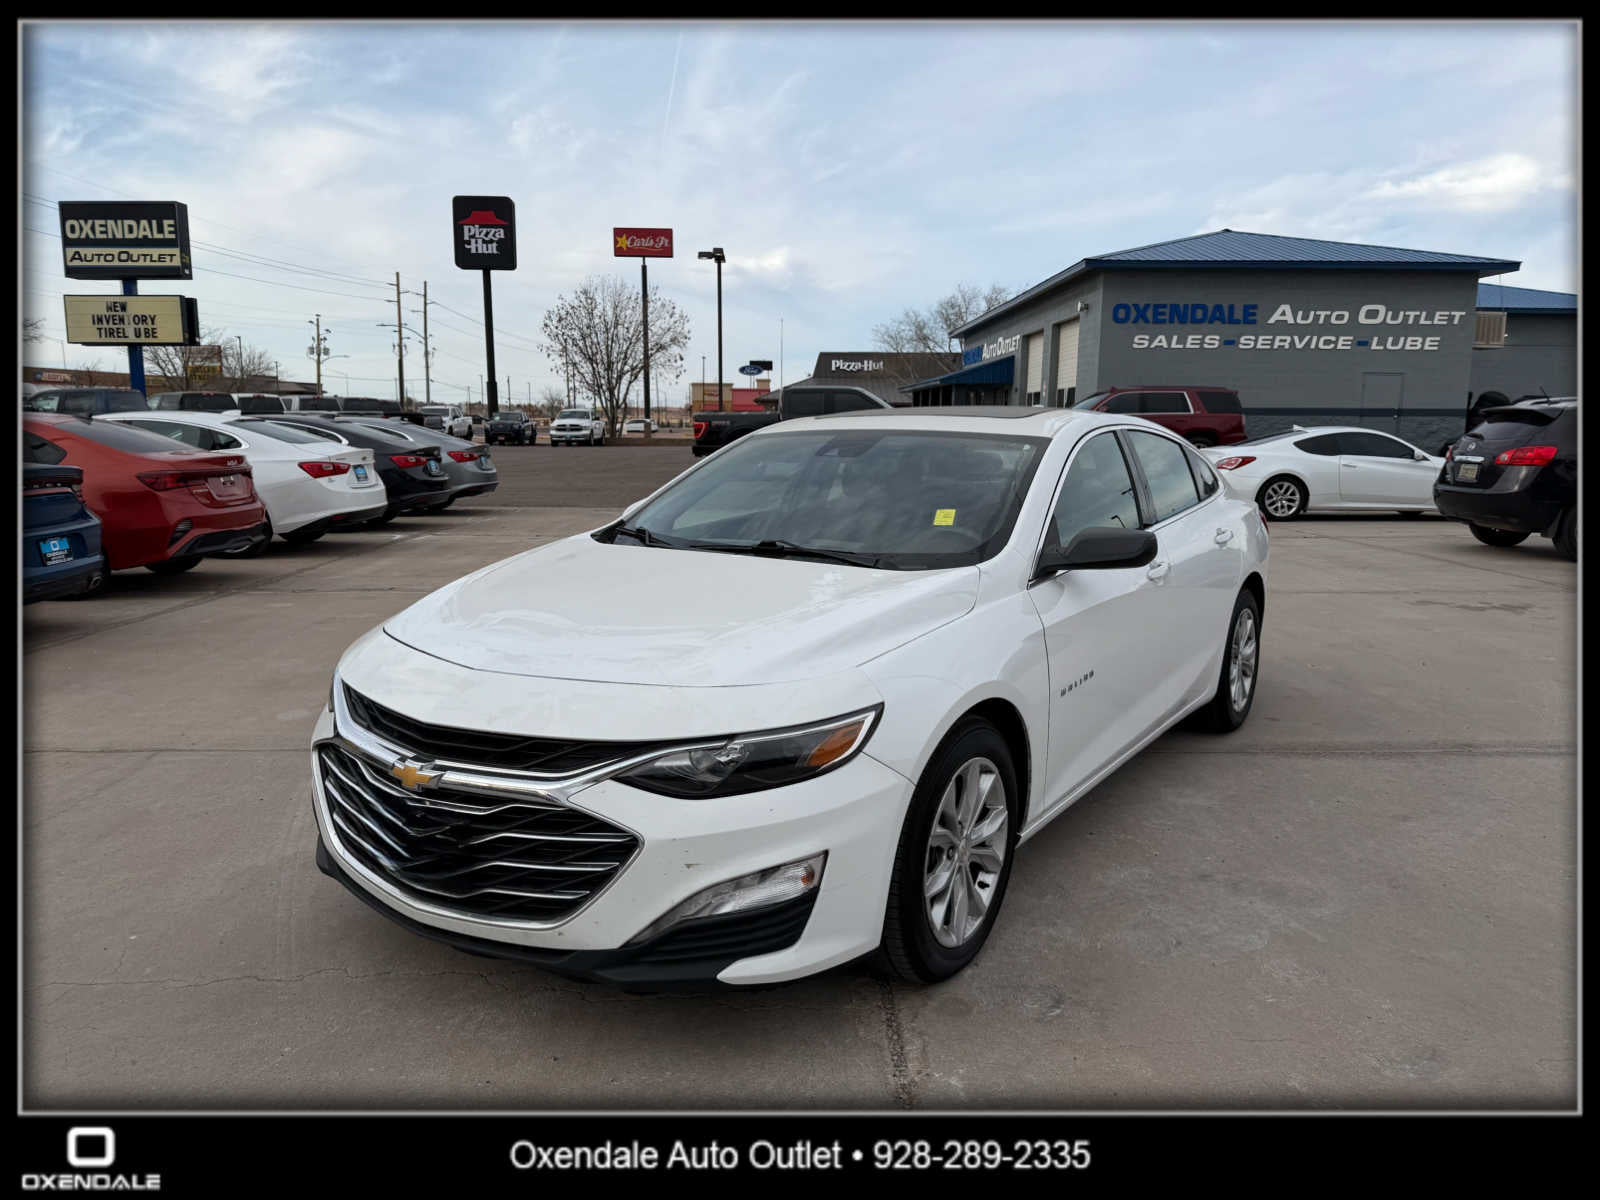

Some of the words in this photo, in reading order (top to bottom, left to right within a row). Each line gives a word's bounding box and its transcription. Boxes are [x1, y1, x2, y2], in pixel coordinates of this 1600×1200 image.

[65, 219, 176, 239] OXENDALE
[463, 224, 505, 241] Pizza
[464, 238, 500, 255] Hut
[106, 301, 128, 313] NEW
[1112, 303, 1258, 325] OXENDALE
